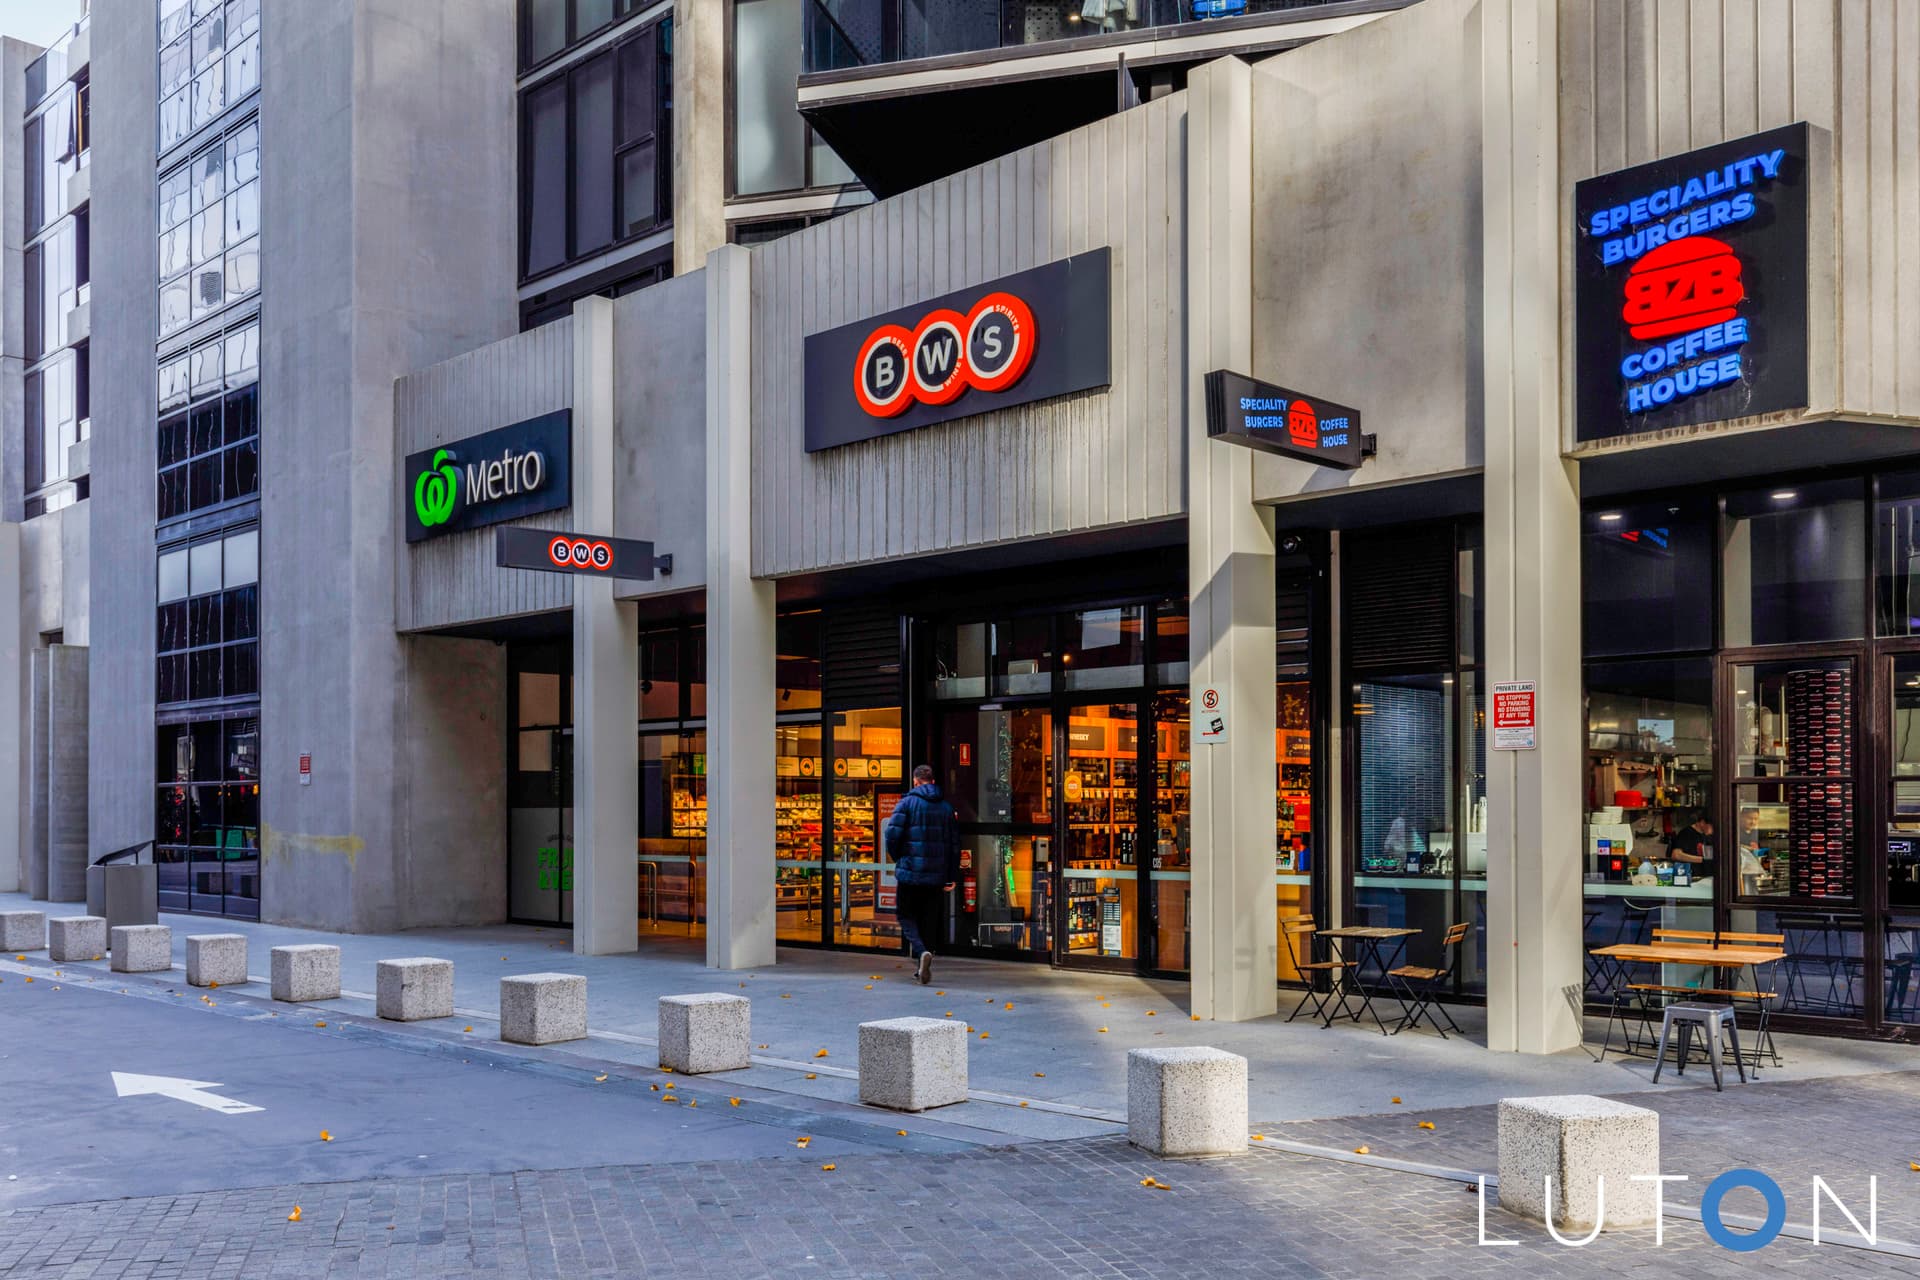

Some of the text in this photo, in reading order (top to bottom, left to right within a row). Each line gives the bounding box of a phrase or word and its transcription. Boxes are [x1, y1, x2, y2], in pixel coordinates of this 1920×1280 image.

[1590, 149, 1785, 237] SPECIALITY
[1602, 192, 1755, 266] BURGERS
[995, 304, 1020, 331] SPIRITS
[891, 337, 908, 357] BEER
[1621, 317, 1748, 379] COFFEE
[944, 361, 962, 387] WINE
[1628, 353, 1742, 413] HOUSE
[1240, 397, 1288, 411] SPECIALITY
[1245, 415, 1284, 428] BURGERS
[1320, 417, 1349, 431] COFFEE
[1322, 434, 1348, 448] HOUSE
[466, 449, 541, 505] Metro
